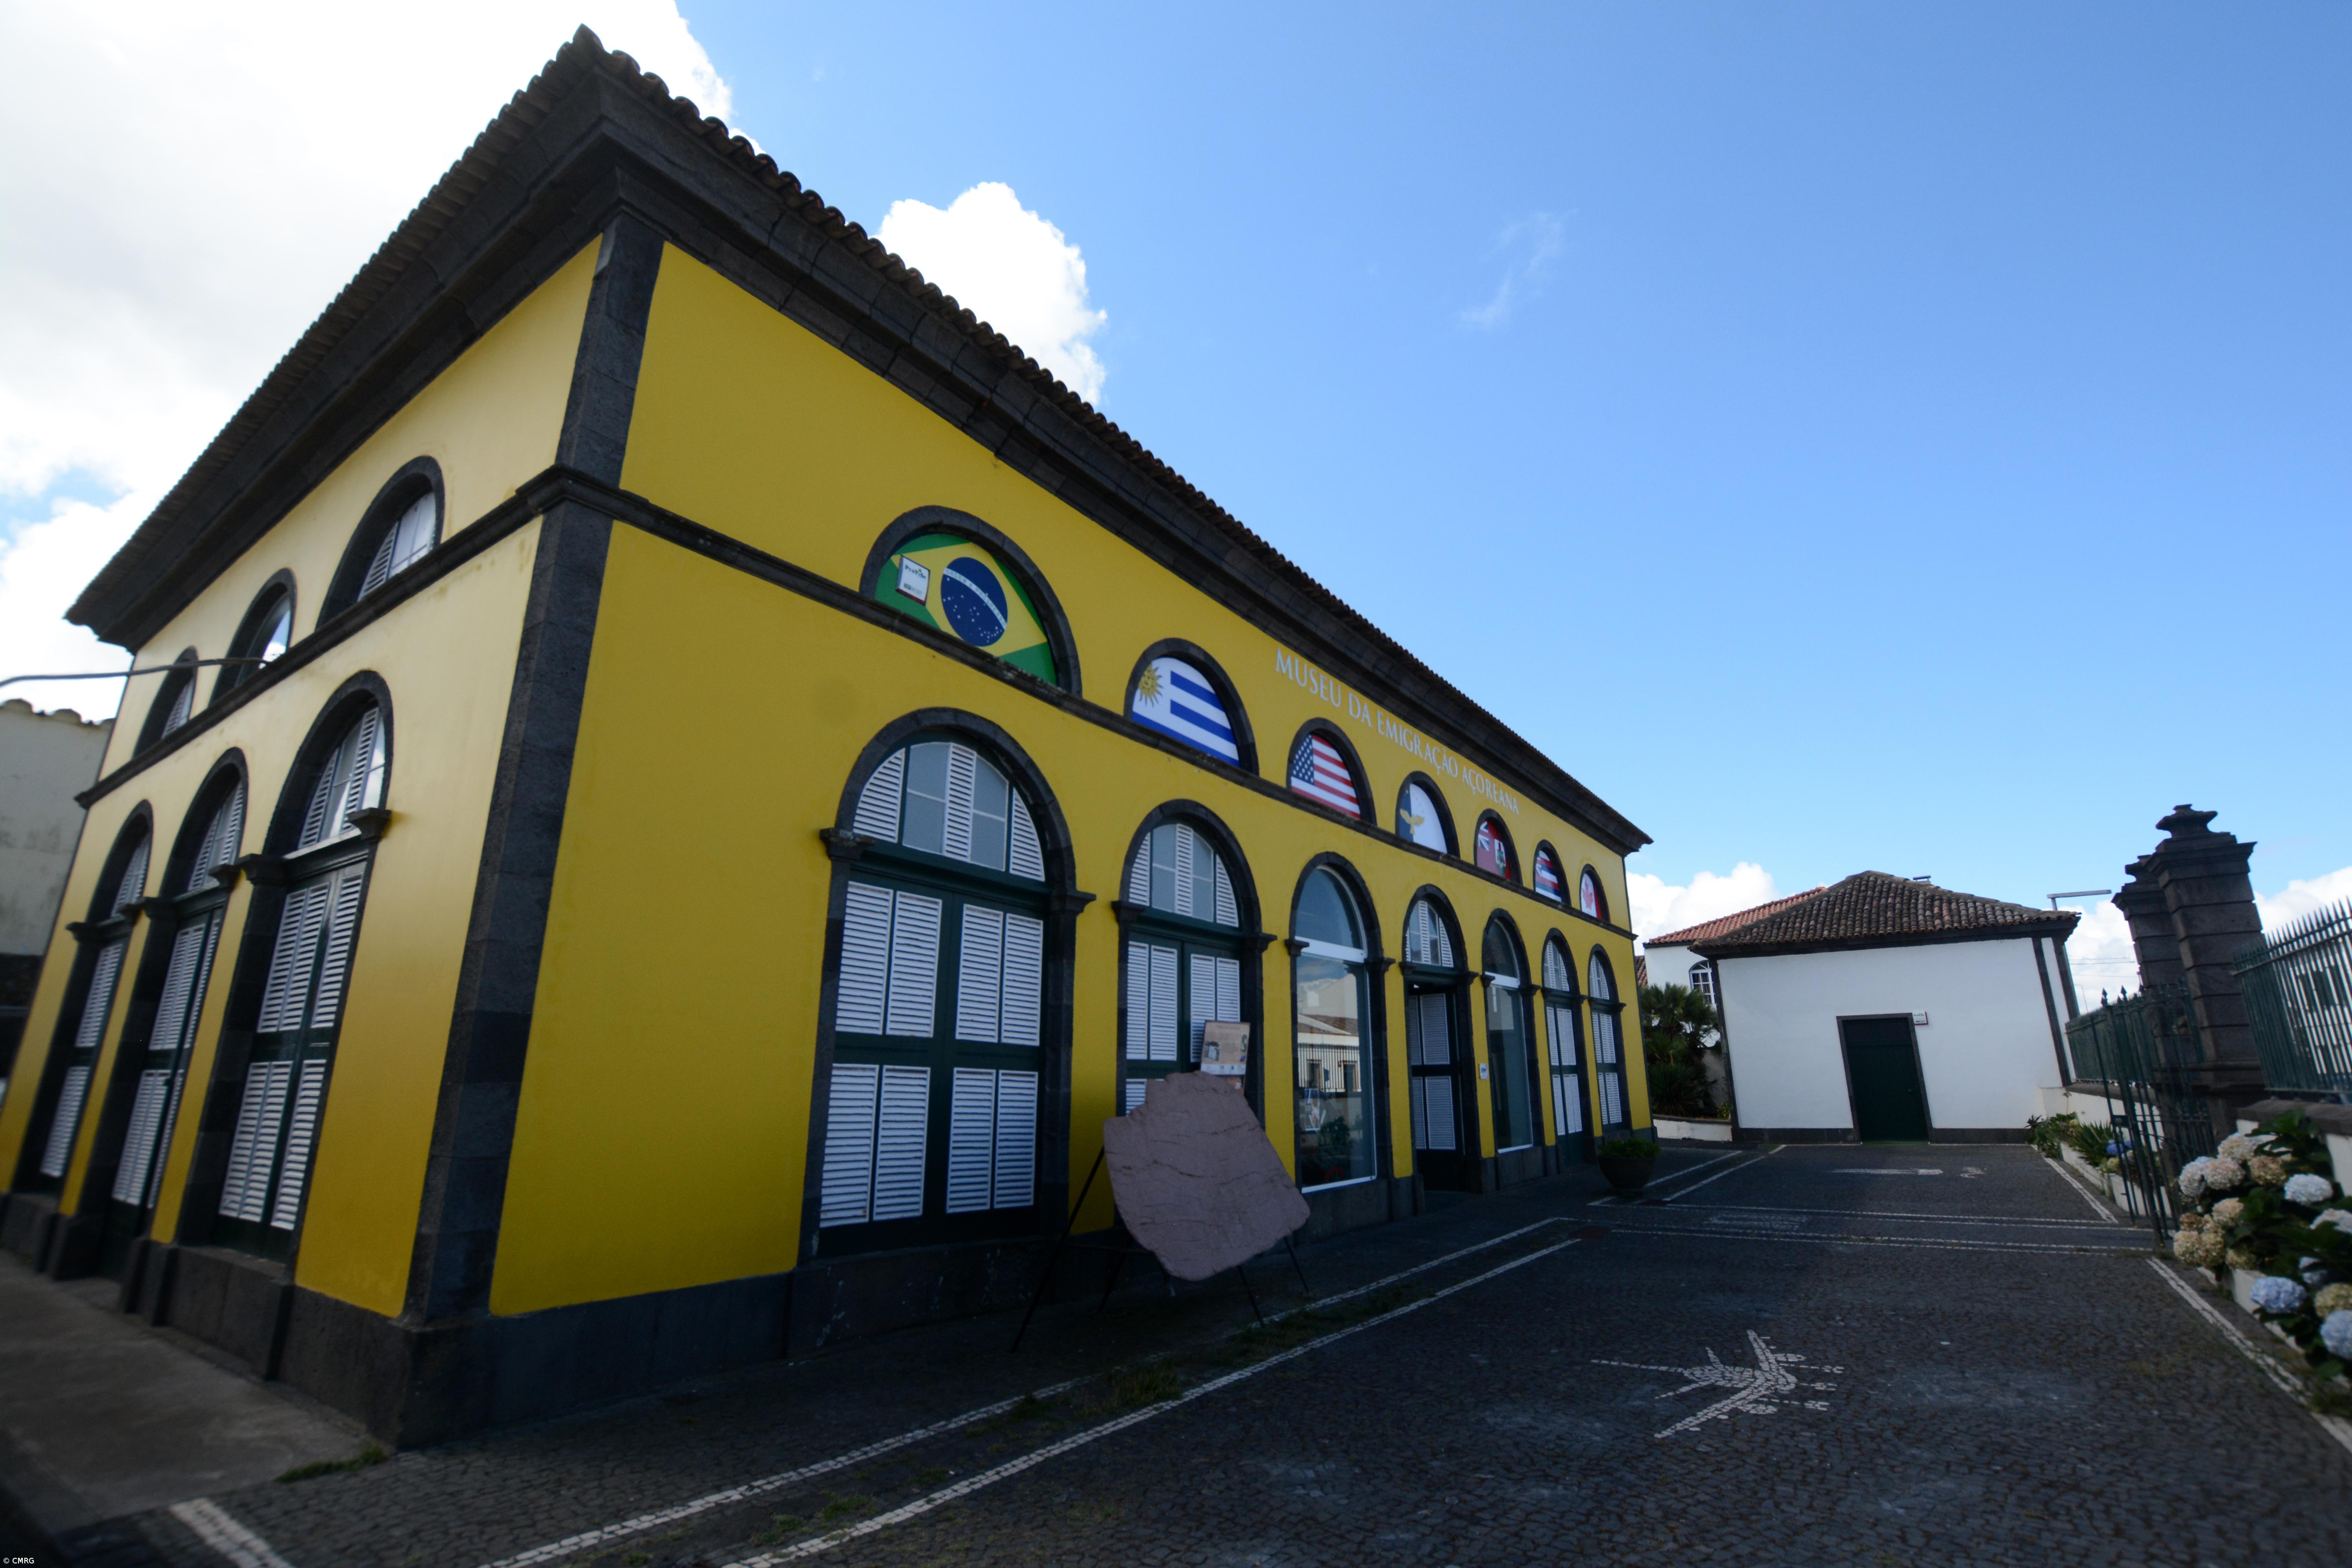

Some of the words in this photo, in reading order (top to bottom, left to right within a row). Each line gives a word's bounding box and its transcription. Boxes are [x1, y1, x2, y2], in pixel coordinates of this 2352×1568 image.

[1276, 646, 1341, 707] MUSEU
[1348, 691, 1372, 728] DA
[1376, 710, 1458, 778] EMIGRAÇÃO
[1462, 766, 1519, 815] AÇOREANA
